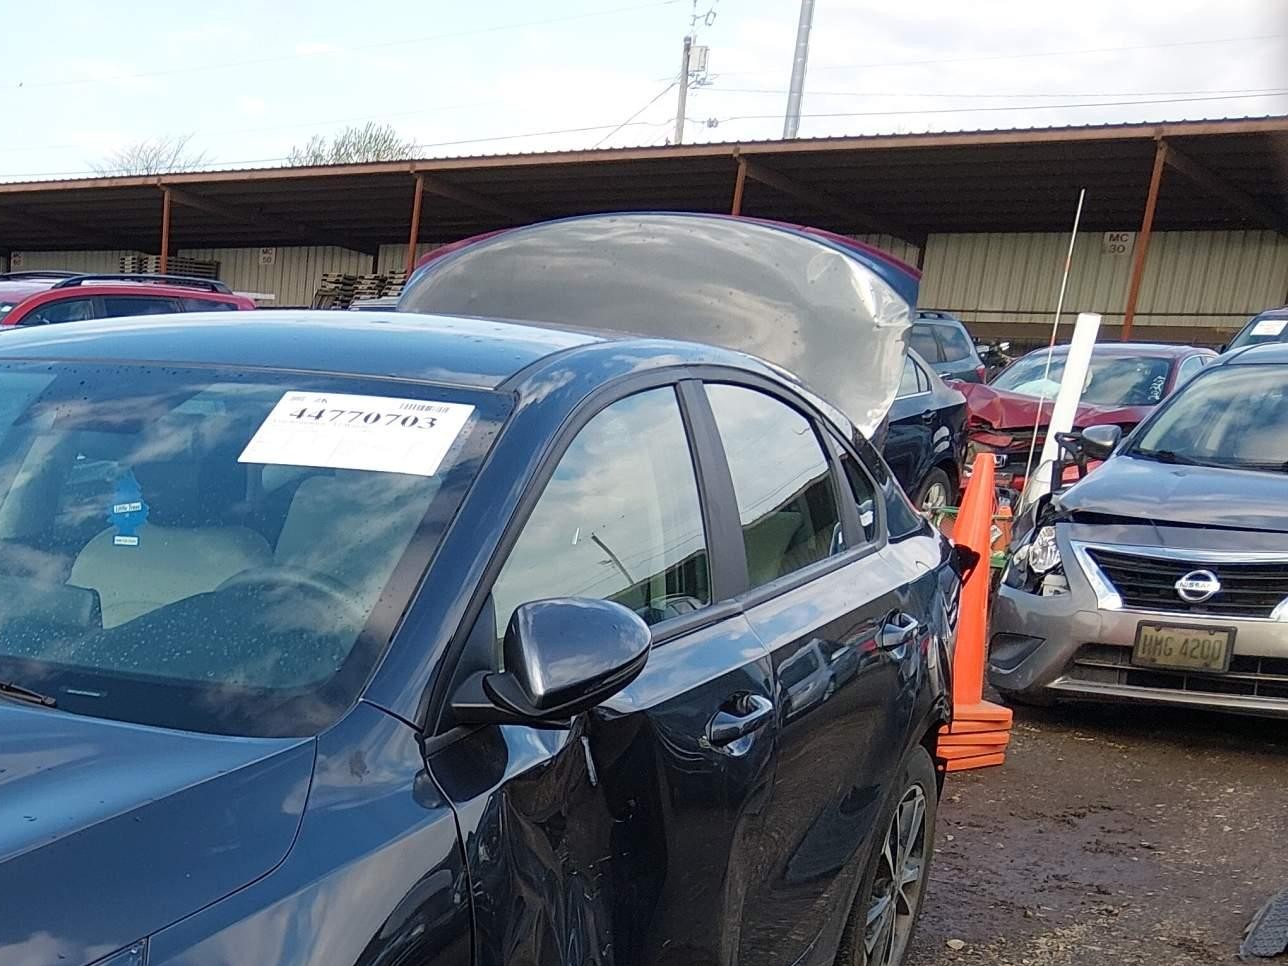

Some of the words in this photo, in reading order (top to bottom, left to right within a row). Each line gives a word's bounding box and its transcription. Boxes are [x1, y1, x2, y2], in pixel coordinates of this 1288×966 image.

[1108, 233, 1129, 242] MC
[1108, 244, 1126, 253] 30
[289, 407, 439, 429] 44770703
[1178, 637, 1223, 661] 4200
